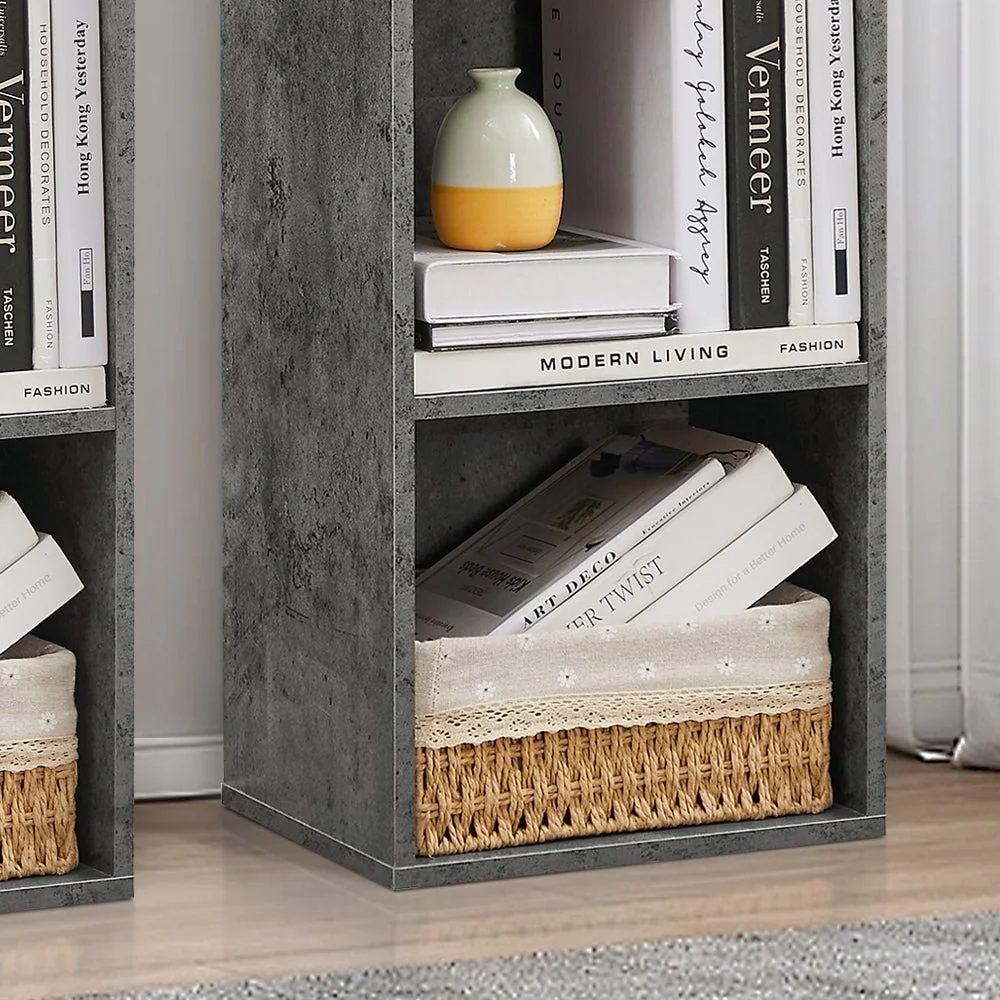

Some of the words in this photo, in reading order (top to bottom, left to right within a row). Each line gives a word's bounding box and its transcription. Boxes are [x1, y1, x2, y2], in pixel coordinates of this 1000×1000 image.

[39, 23, 49, 123] HOUSEHOLD
[74, 19, 89, 100] Yesterday
[830, 69, 845, 111] Kong
[76, 103, 91, 146] Kong
[745, 36, 781, 214] Vermeer
[796, 95, 807, 188] DECORATES
[831, 114, 846, 159] Hong
[40, 129, 51, 226] DECORATES
[77, 151, 92, 196] Hong
[760, 246, 771, 304] TASCHEN
[800, 258, 809, 307] FASHION
[3, 287, 14, 347] TASCHEN
[45, 299, 54, 350] FASHION
[540, 351, 640, 371] MODERN
[652, 345, 730, 364] LIVING
[779, 339, 845, 353] FASHION
[23, 383, 91, 398] FASHION
[21, 573, 52, 601] Home
[522, 594, 557, 629] ART
[565, 551, 617, 594] DECO
[599, 555, 665, 613] TWIST
[694, 584, 728, 613] Design
[726, 573, 742, 588] for
[749, 546, 777, 571] Better
[777, 522, 806, 548] Home
